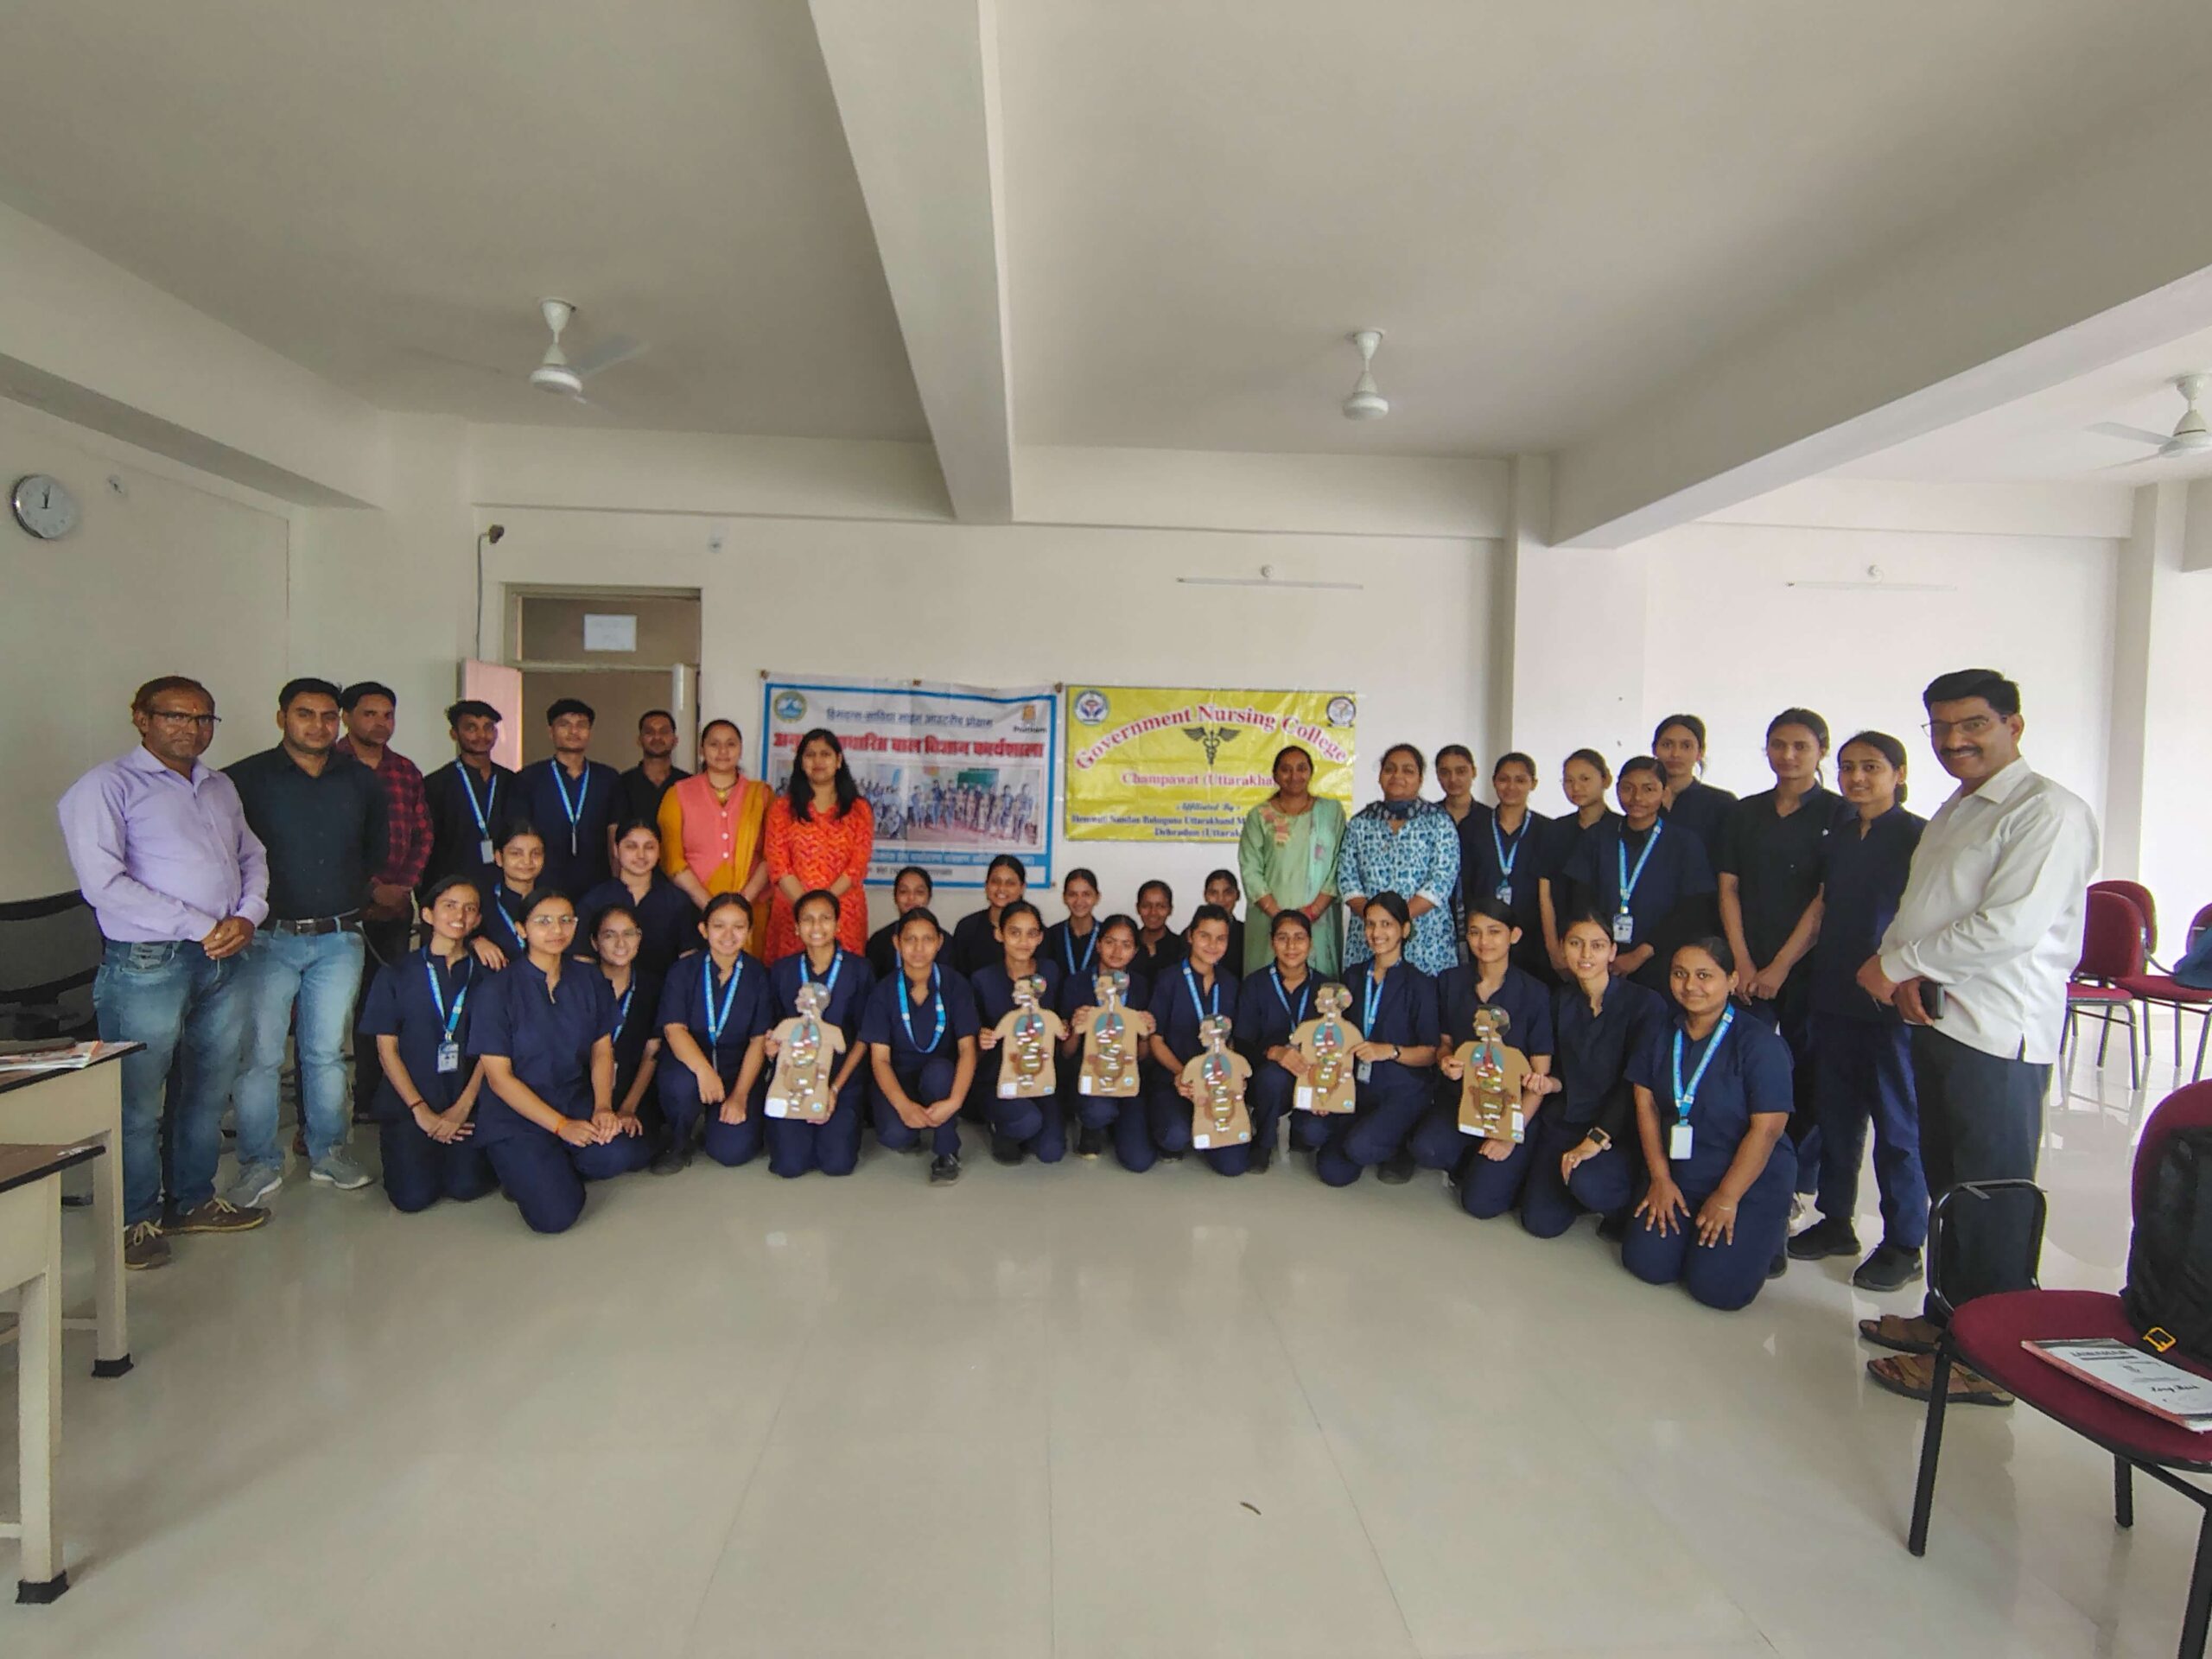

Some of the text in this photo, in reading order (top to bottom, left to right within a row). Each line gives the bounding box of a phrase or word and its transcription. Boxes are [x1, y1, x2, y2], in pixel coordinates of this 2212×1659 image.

[1076, 705, 1347, 768] Government Nursing College
[1122, 773, 1199, 787] Champawat
[1185, 816, 1235, 825] Uttarakhand
